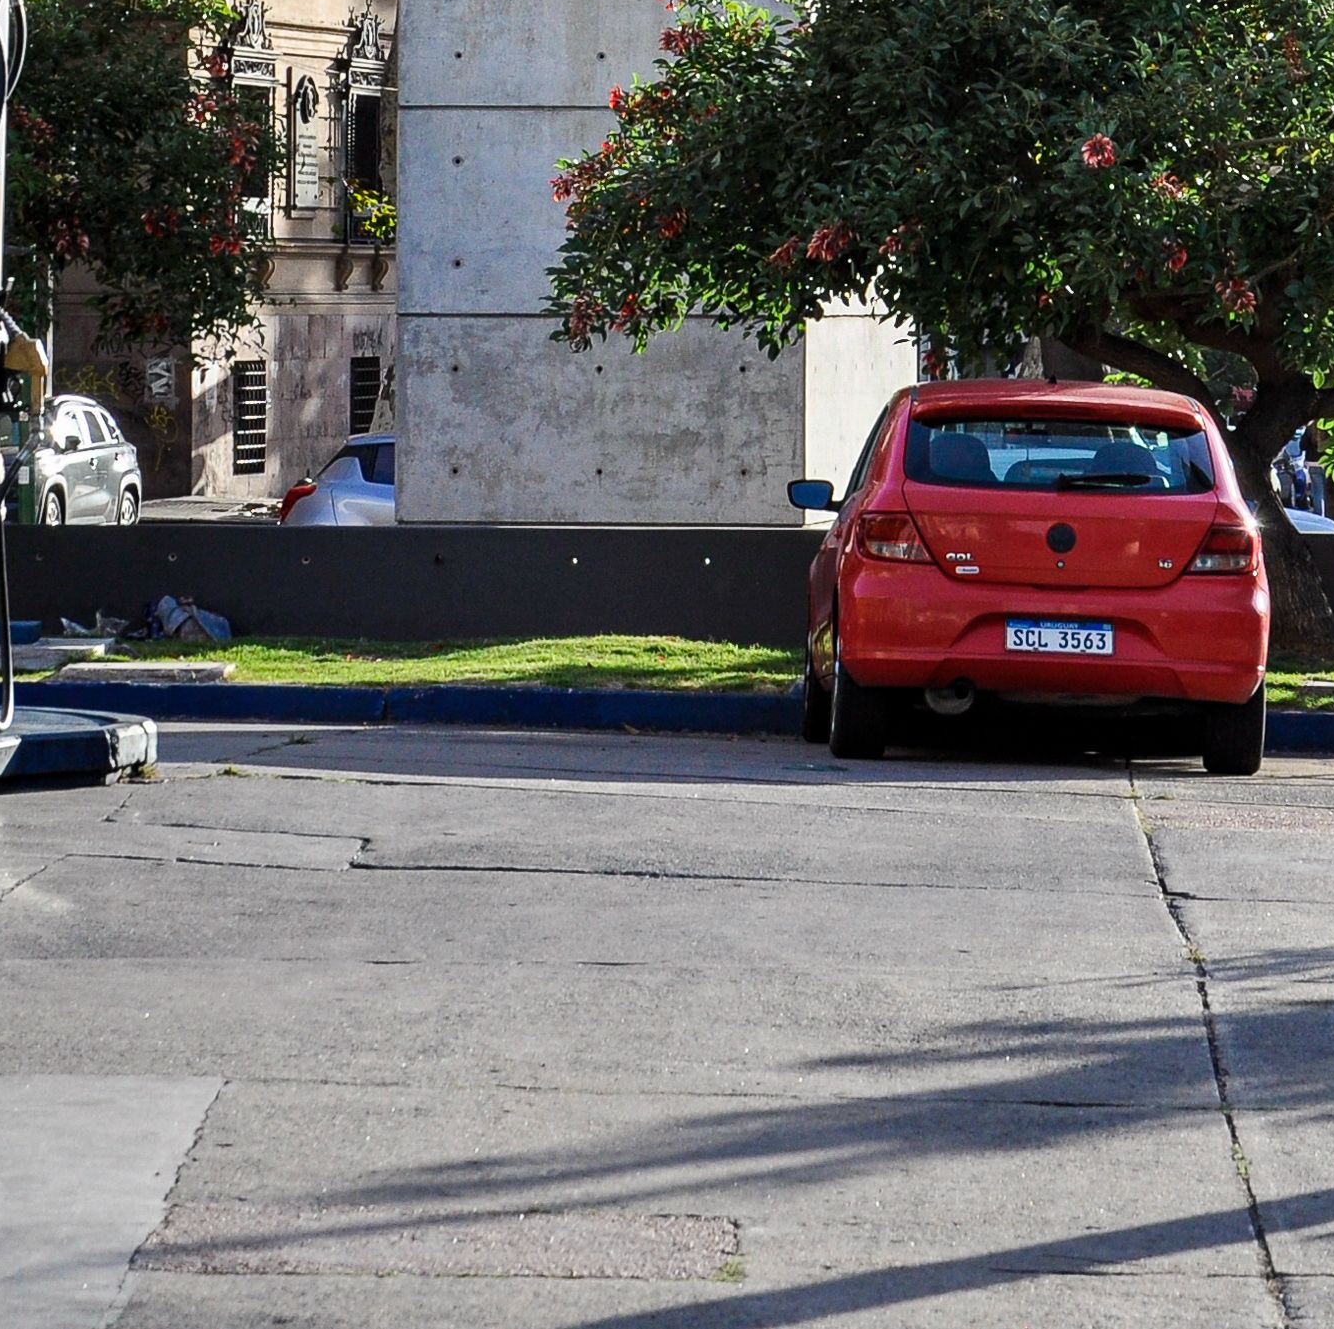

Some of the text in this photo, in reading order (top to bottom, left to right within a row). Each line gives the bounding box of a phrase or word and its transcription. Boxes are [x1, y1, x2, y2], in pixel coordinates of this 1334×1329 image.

[946, 552, 974, 561] GOL
[1012, 628, 1107, 650] SCL 3563
